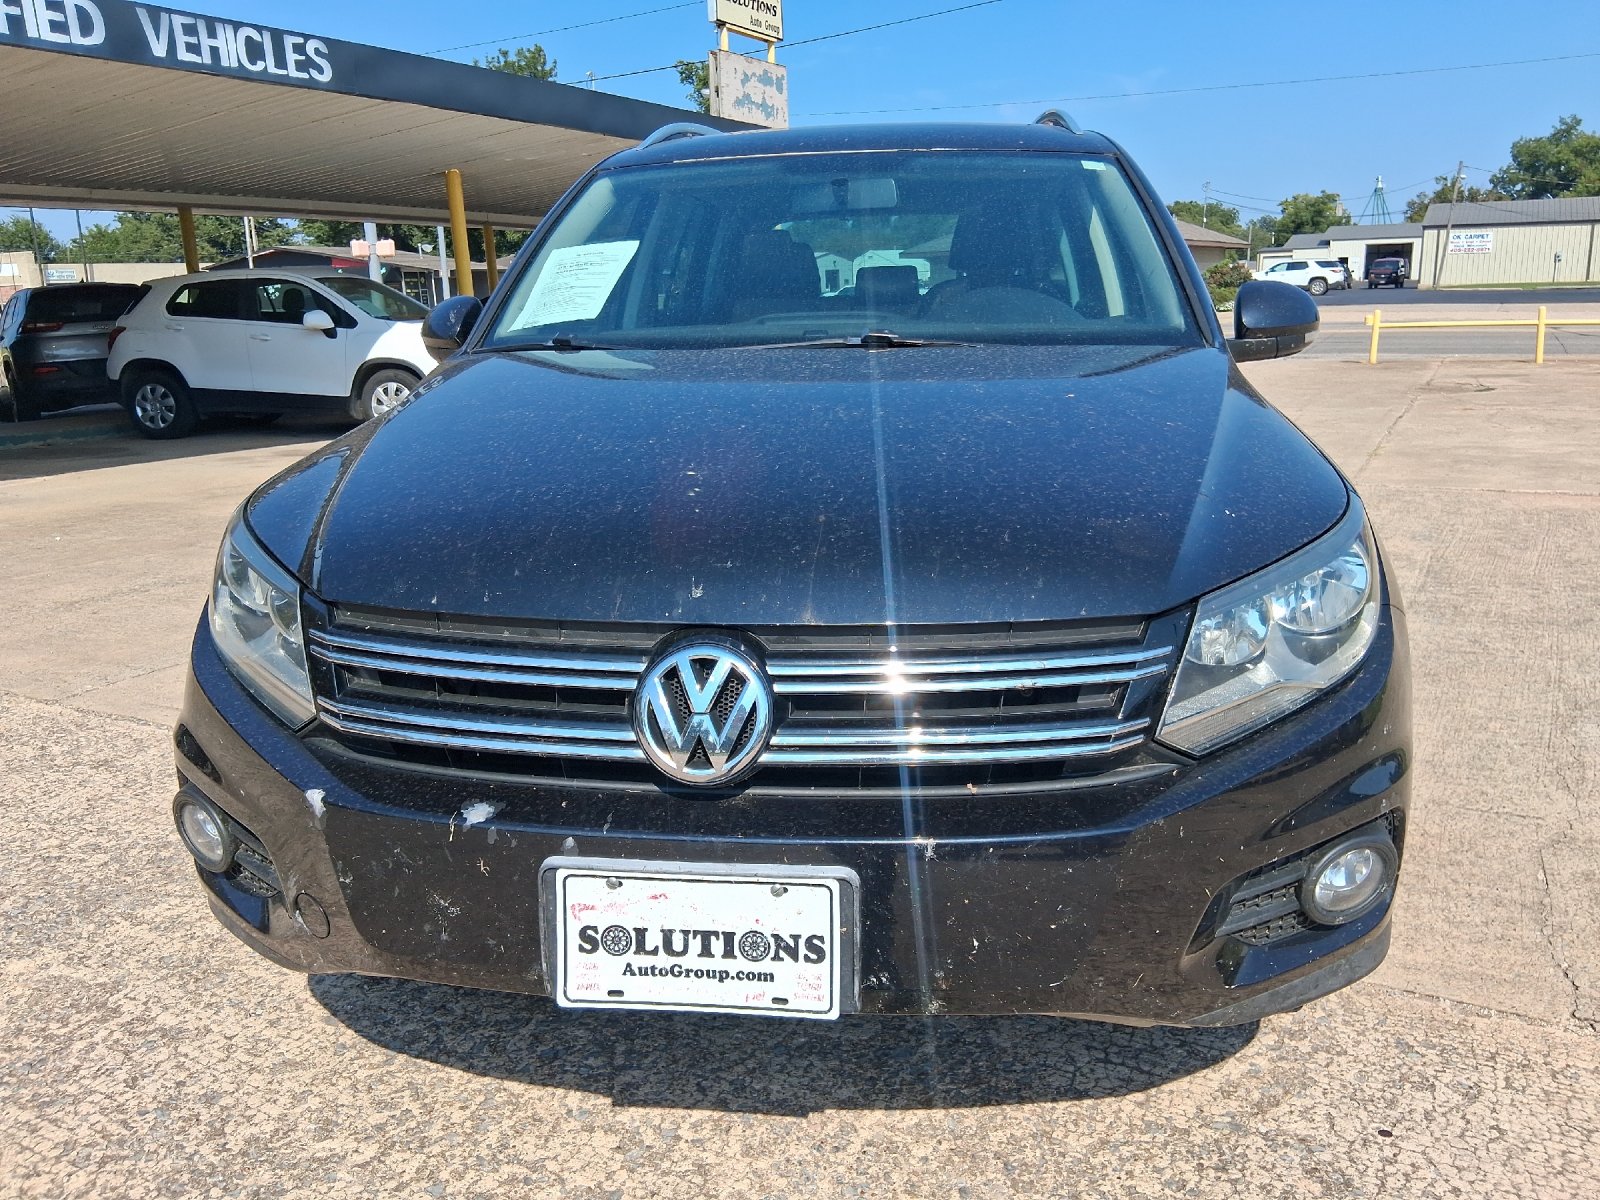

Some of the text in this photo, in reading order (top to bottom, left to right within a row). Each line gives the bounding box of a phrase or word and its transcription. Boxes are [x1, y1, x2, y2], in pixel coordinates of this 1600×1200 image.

[725, 0, 777, 17] LUTIONS
[750, 15, 780, 36] Auto Group
[136, 7, 332, 82] VEHICLES
[578, 925, 826, 964] SOLUTIONS
[621, 962, 774, 983] AutoGroup.com
